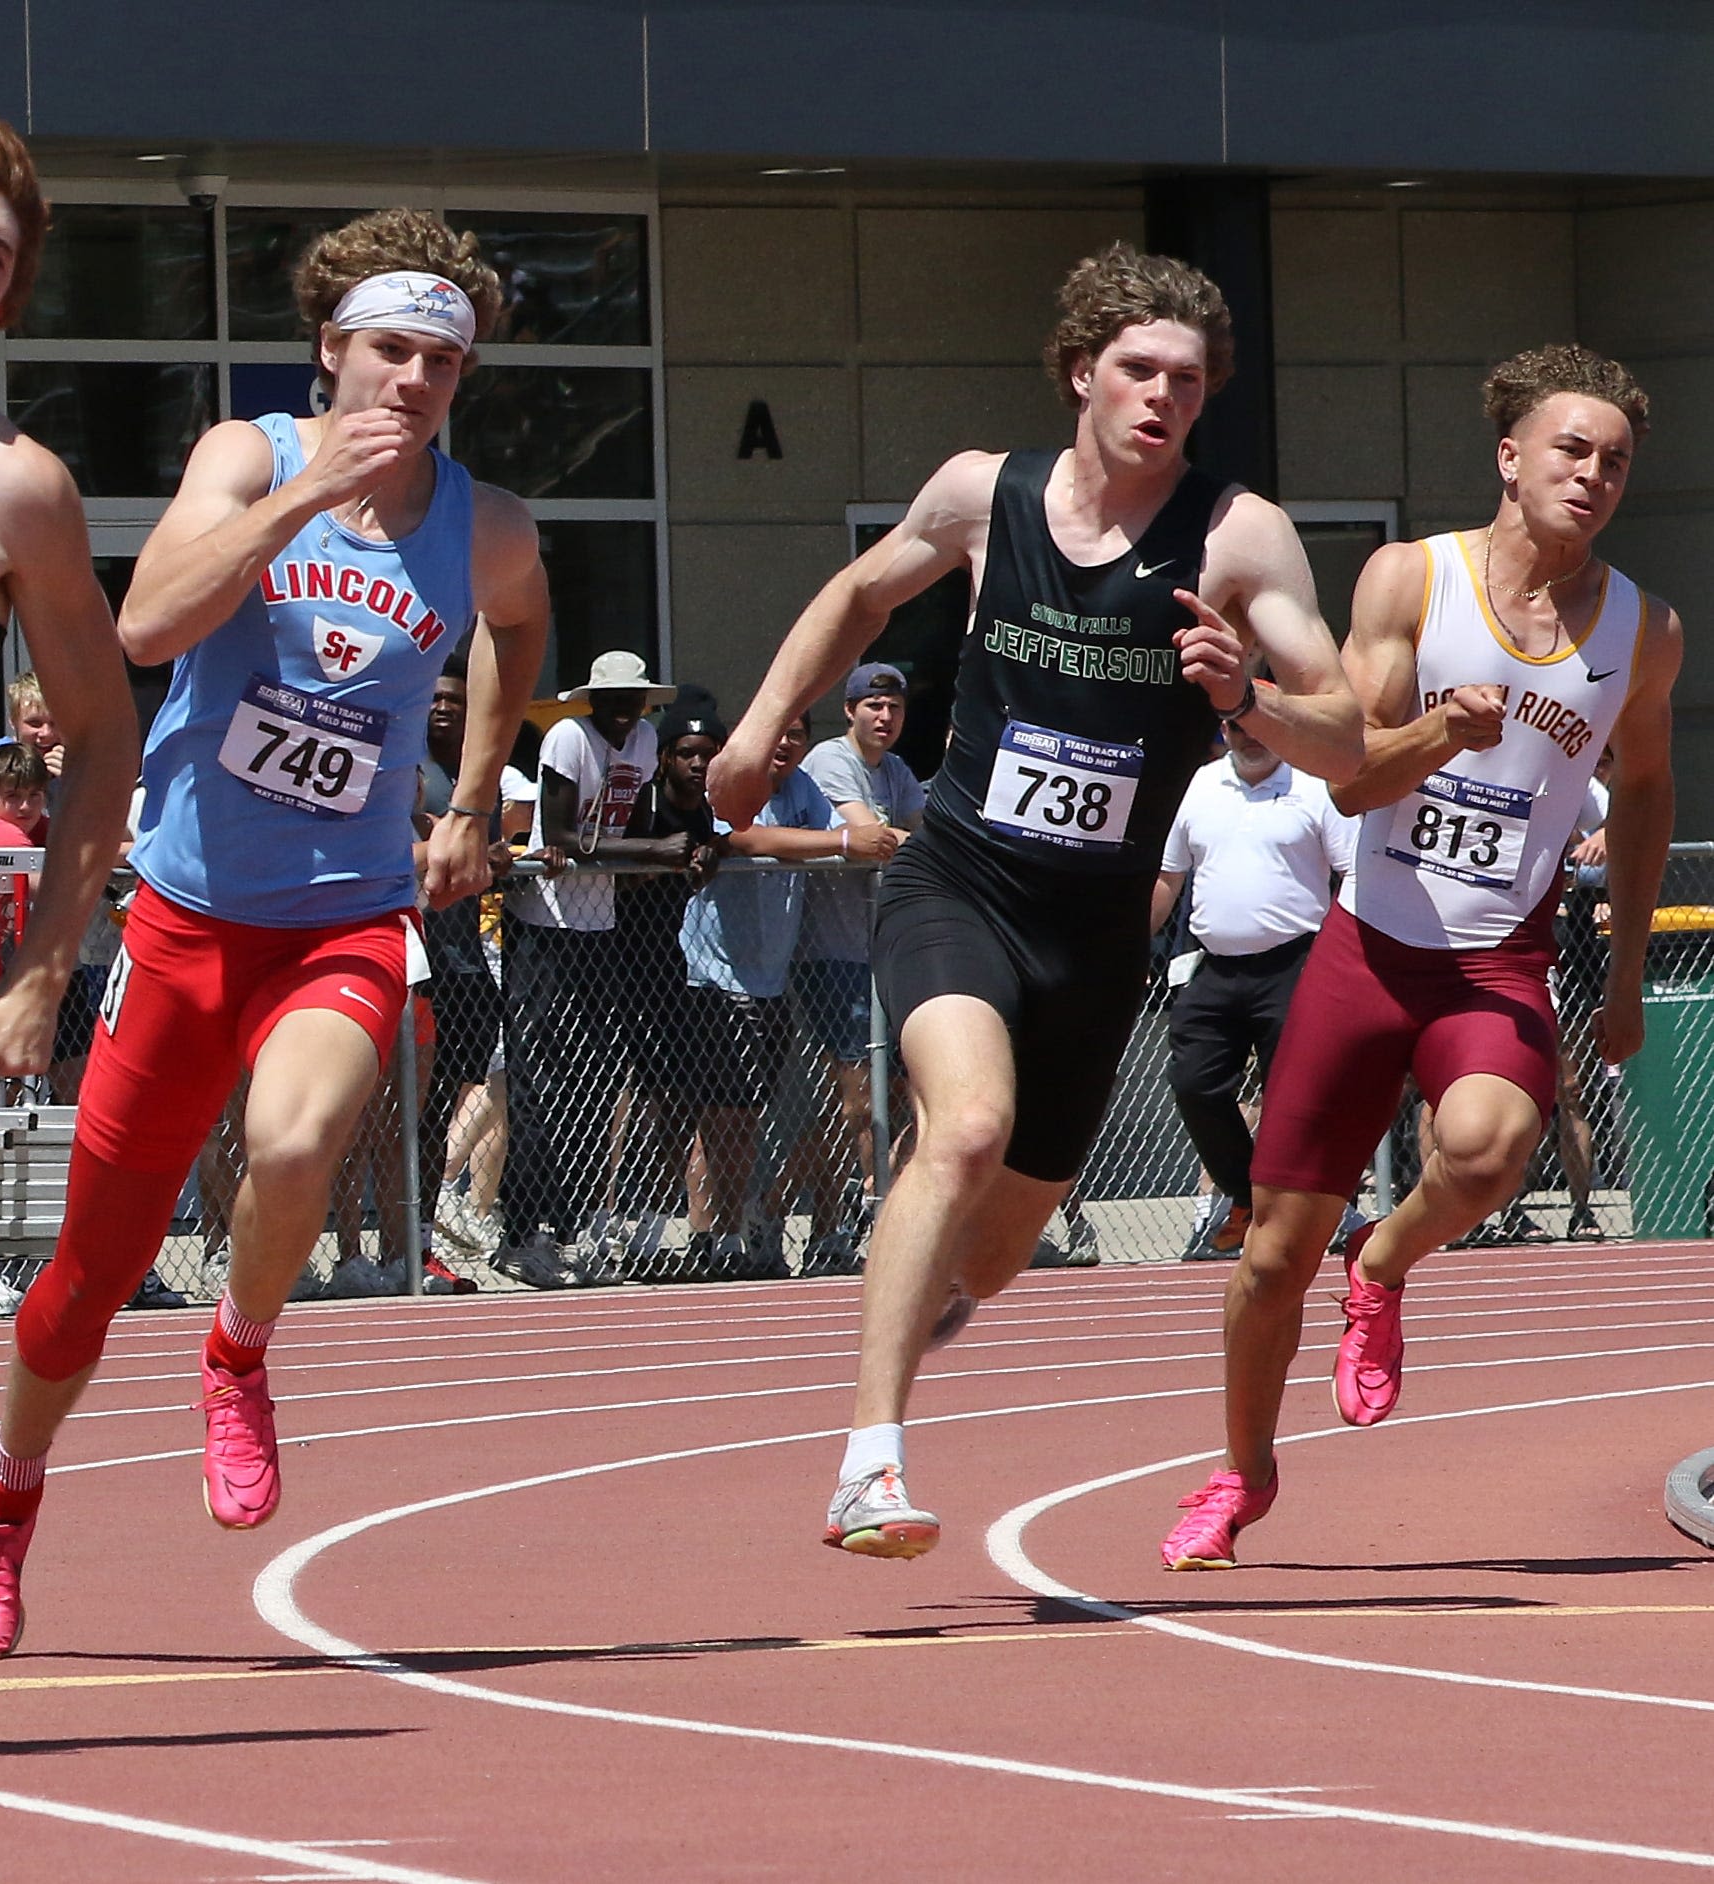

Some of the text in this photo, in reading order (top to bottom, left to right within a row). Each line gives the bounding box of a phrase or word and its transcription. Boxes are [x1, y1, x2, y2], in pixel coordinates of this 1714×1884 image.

[736, 400, 783, 460] A
[259, 560, 446, 655] LINCOLN
[1030, 602, 1131, 635] SIOUX FALLS
[322, 630, 362, 672] SF
[984, 619, 1176, 684] JEFFERSON
[312, 699, 337, 714] STATE
[338, 706, 365, 721] TRACK
[317, 713, 364, 733] FIELD MEET
[1514, 691, 1592, 759] RIDERS
[1013, 731, 1057, 752] SDHSAA
[1064, 739, 1091, 753] STATE
[1092, 744, 1120, 758] TRACK
[248, 721, 354, 798] 749
[1071, 752, 1118, 768] FIELD MEET
[1013, 765, 1112, 832] 738
[1461, 781, 1485, 794] STATE
[1485, 787, 1512, 801] TRACK
[1466, 793, 1488, 805] FIELD
[1021, 829, 1041, 839] MAY
[1411, 804, 1503, 867] 813
